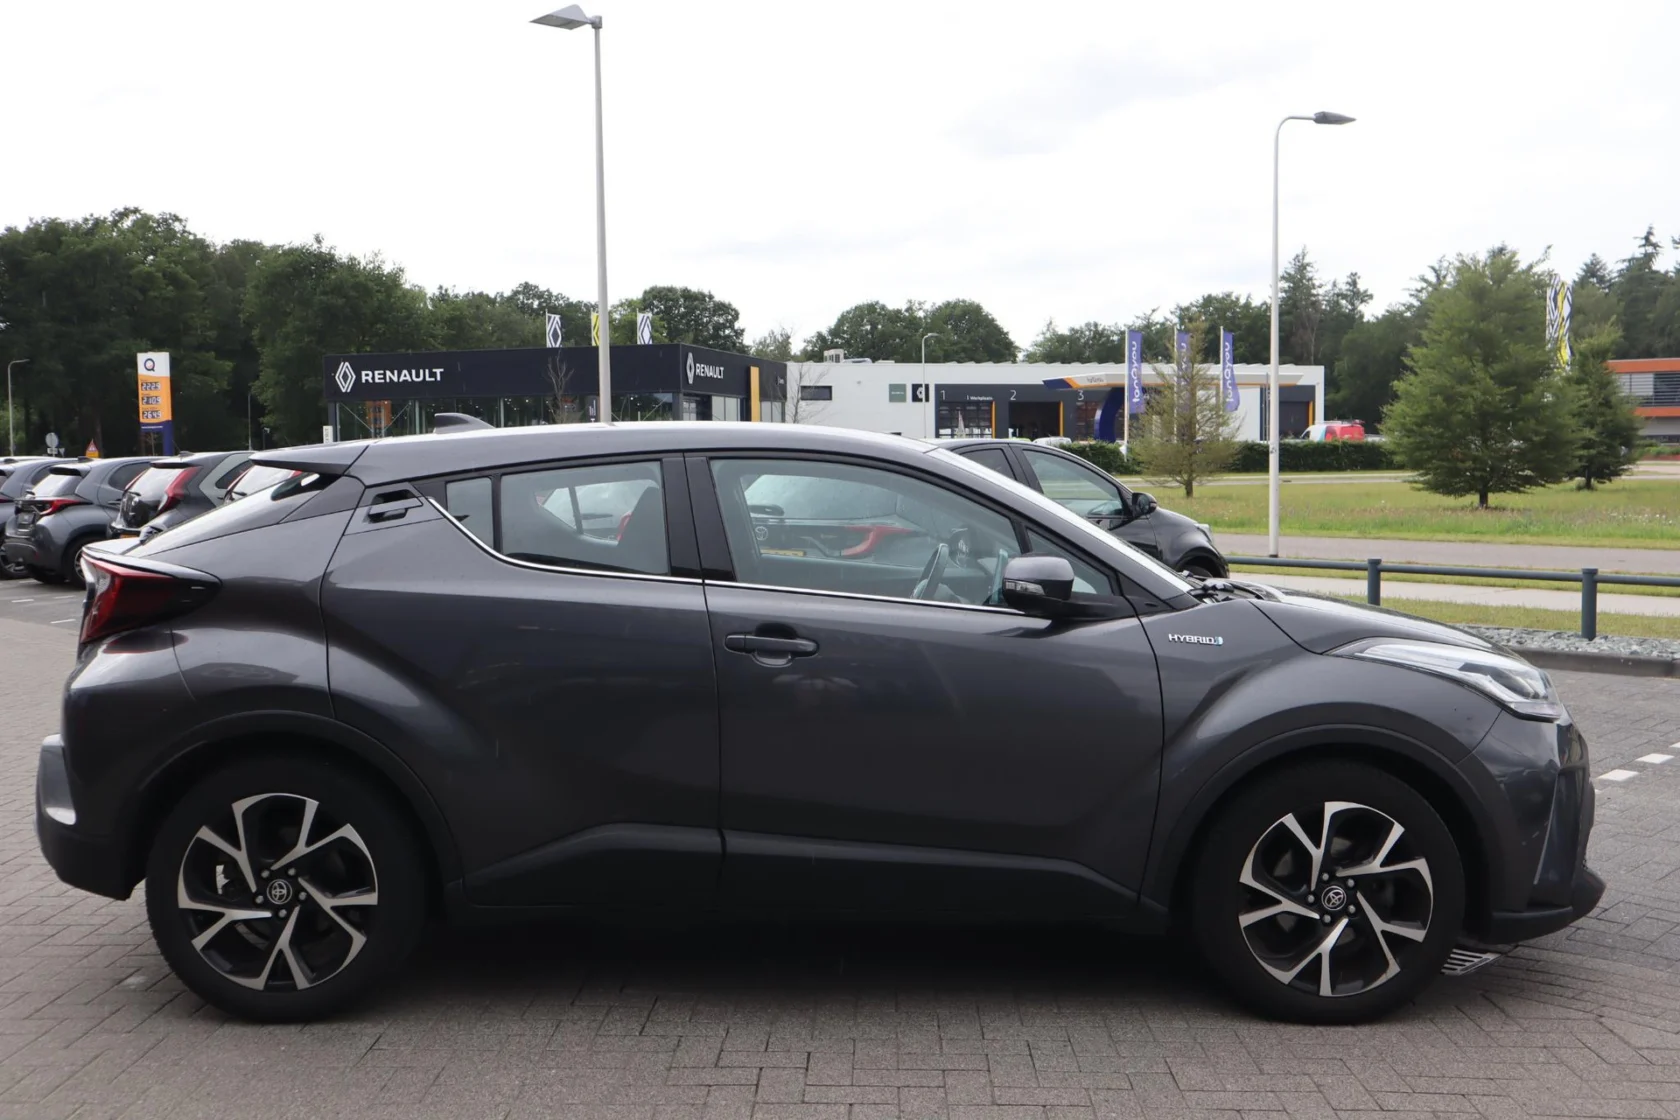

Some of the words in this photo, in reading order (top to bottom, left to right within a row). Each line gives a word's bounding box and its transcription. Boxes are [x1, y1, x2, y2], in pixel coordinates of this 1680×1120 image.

[361, 368, 444, 383] RENAULT
[696, 363, 724, 379] RENAULT
[1010, 390, 1017, 400] 2
[1077, 390, 1084, 400] 3
[1168, 633, 1214, 644] HYBRID
